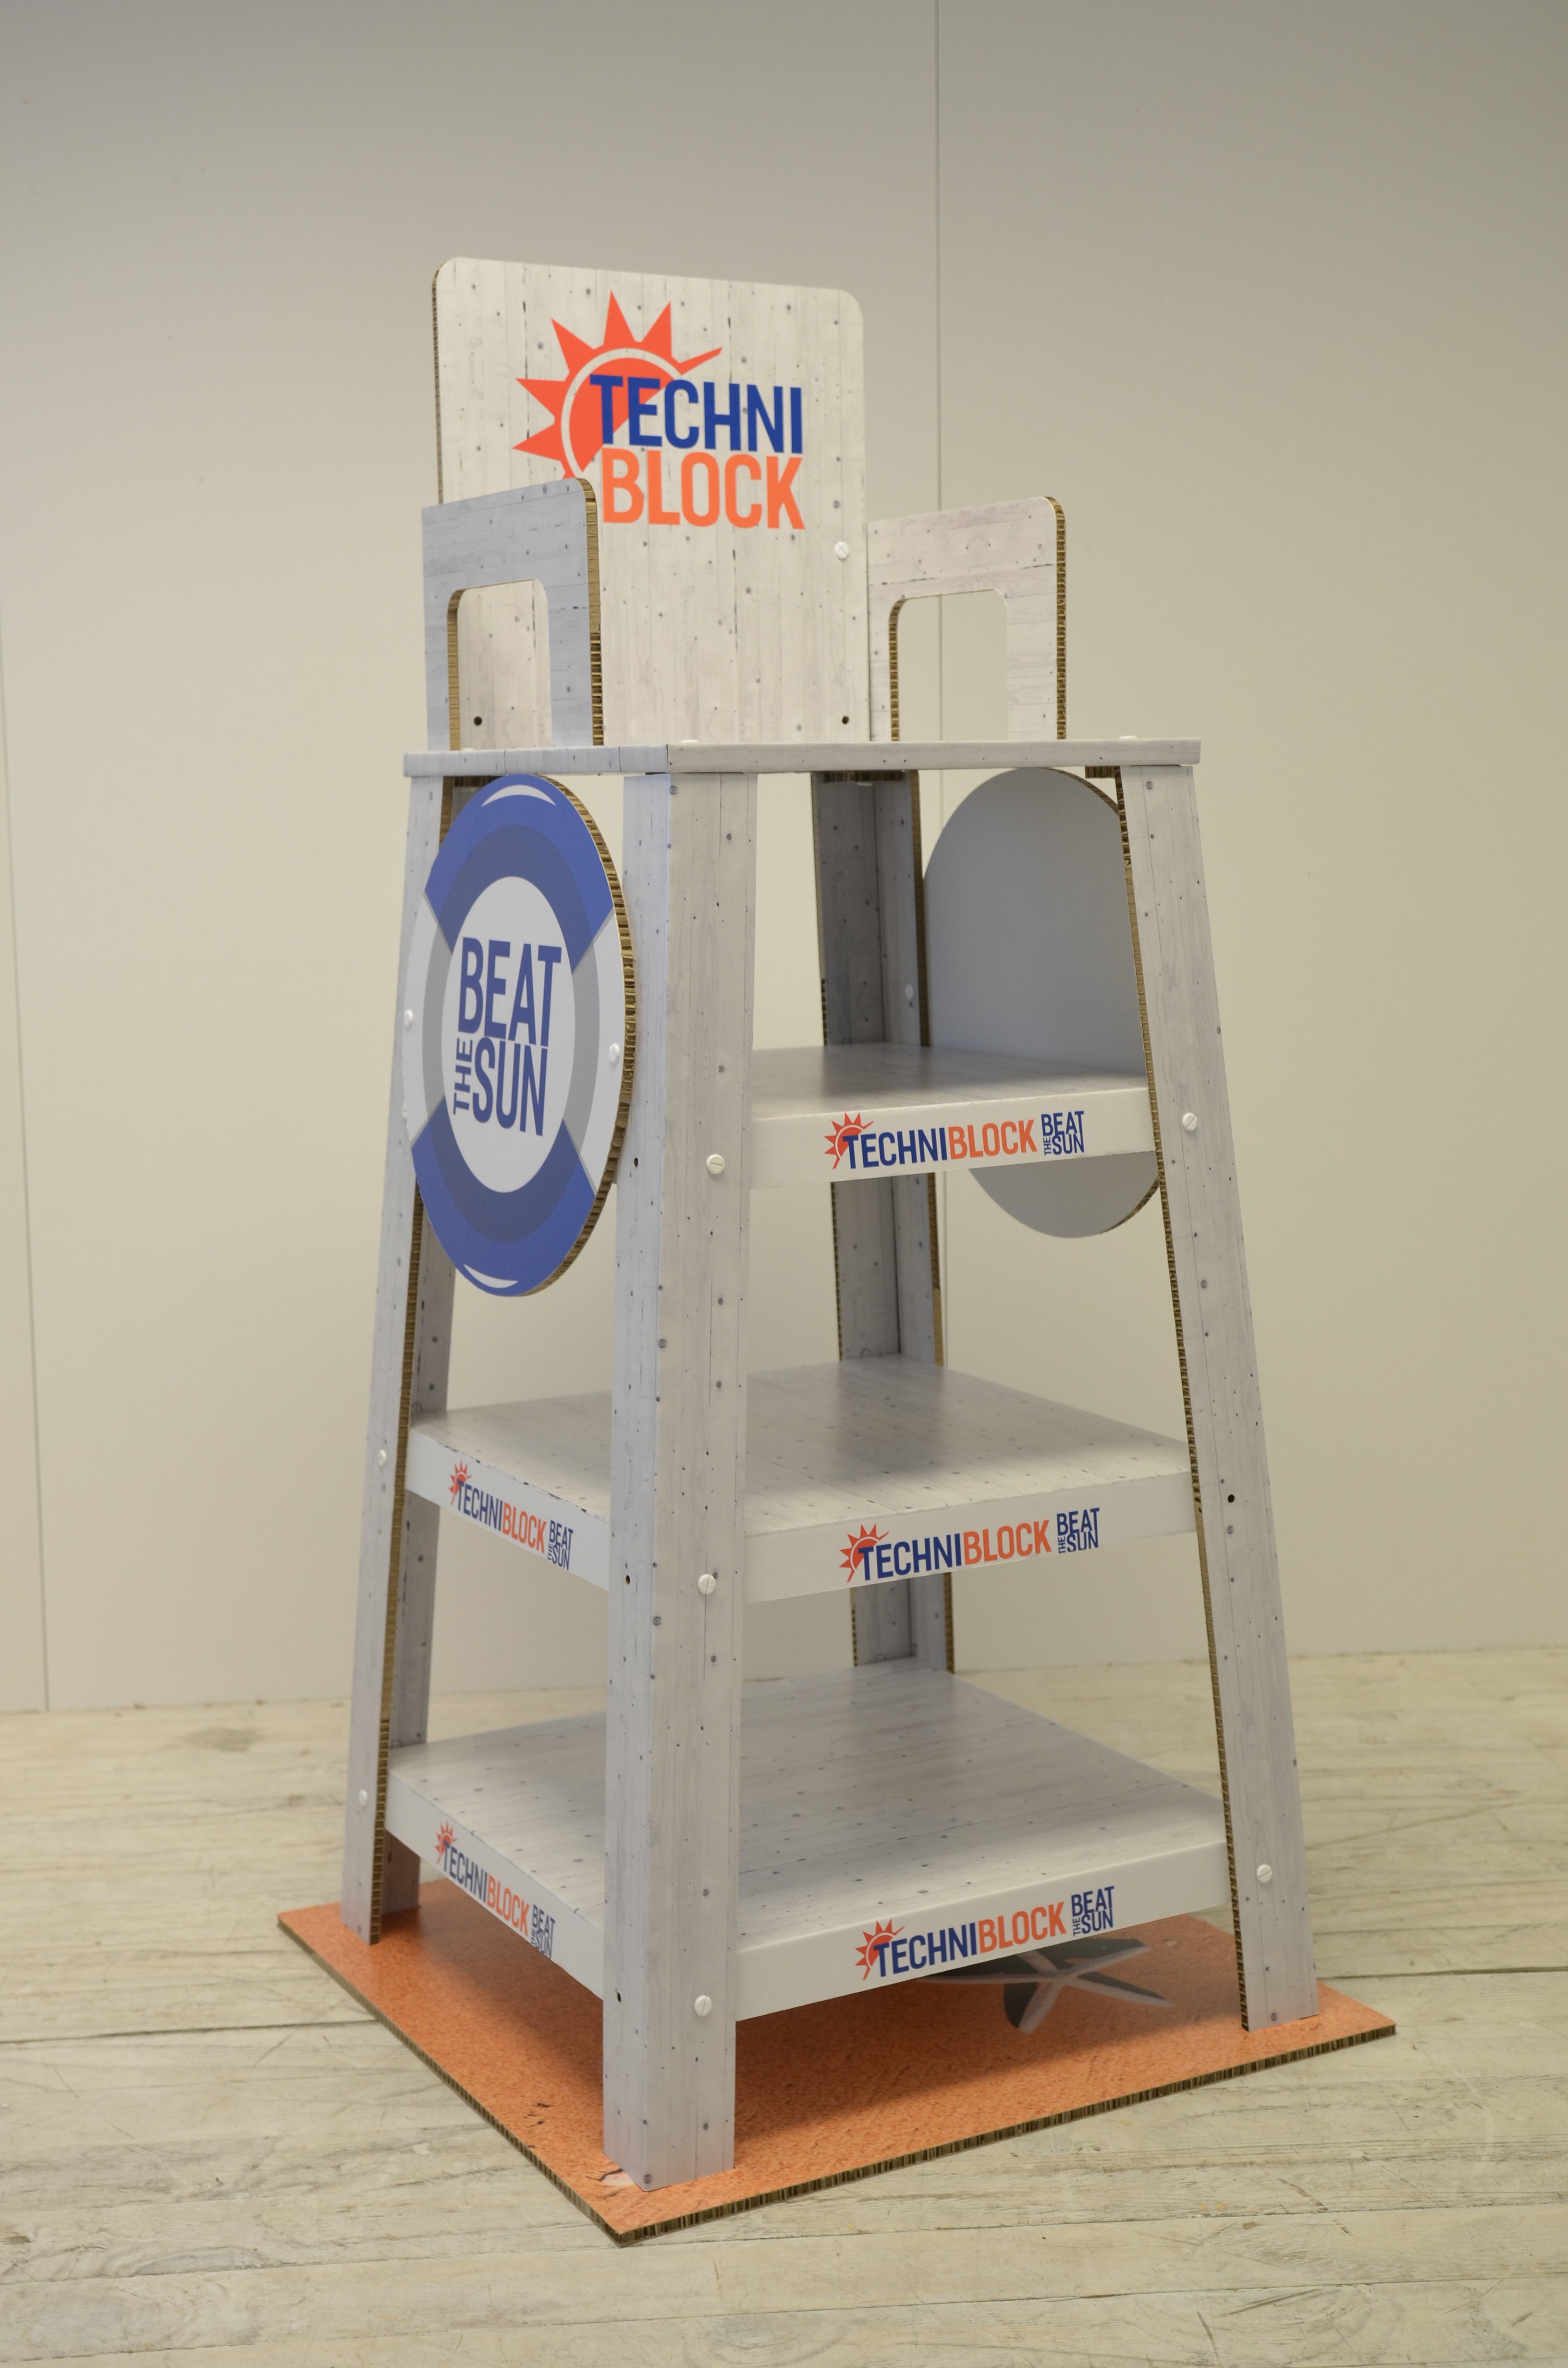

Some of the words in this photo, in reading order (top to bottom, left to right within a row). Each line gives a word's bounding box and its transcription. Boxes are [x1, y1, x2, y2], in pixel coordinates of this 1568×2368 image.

[590, 374, 803, 454] TECHNI
[602, 447, 806, 530] BLOCK
[458, 937, 562, 1047] BEAT
[453, 1039, 473, 1115] THE
[472, 1036, 548, 1137] SUN
[1041, 1110, 1084, 1136] BEAT
[1052, 1133, 1085, 1155] SUN
[549, 1519, 574, 1551] BEAT
[1056, 1507, 1100, 1536] BEAT
[1067, 1529, 1099, 1552] SUN
[552, 1544, 570, 1570] SUN
[1071, 1886, 1115, 1916] BEAT
[532, 1904, 555, 1936] BEAT
[1072, 1916, 1080, 1936] THE
[1081, 1908, 1114, 1935] SUN
[536, 1930, 552, 1959] SUN
